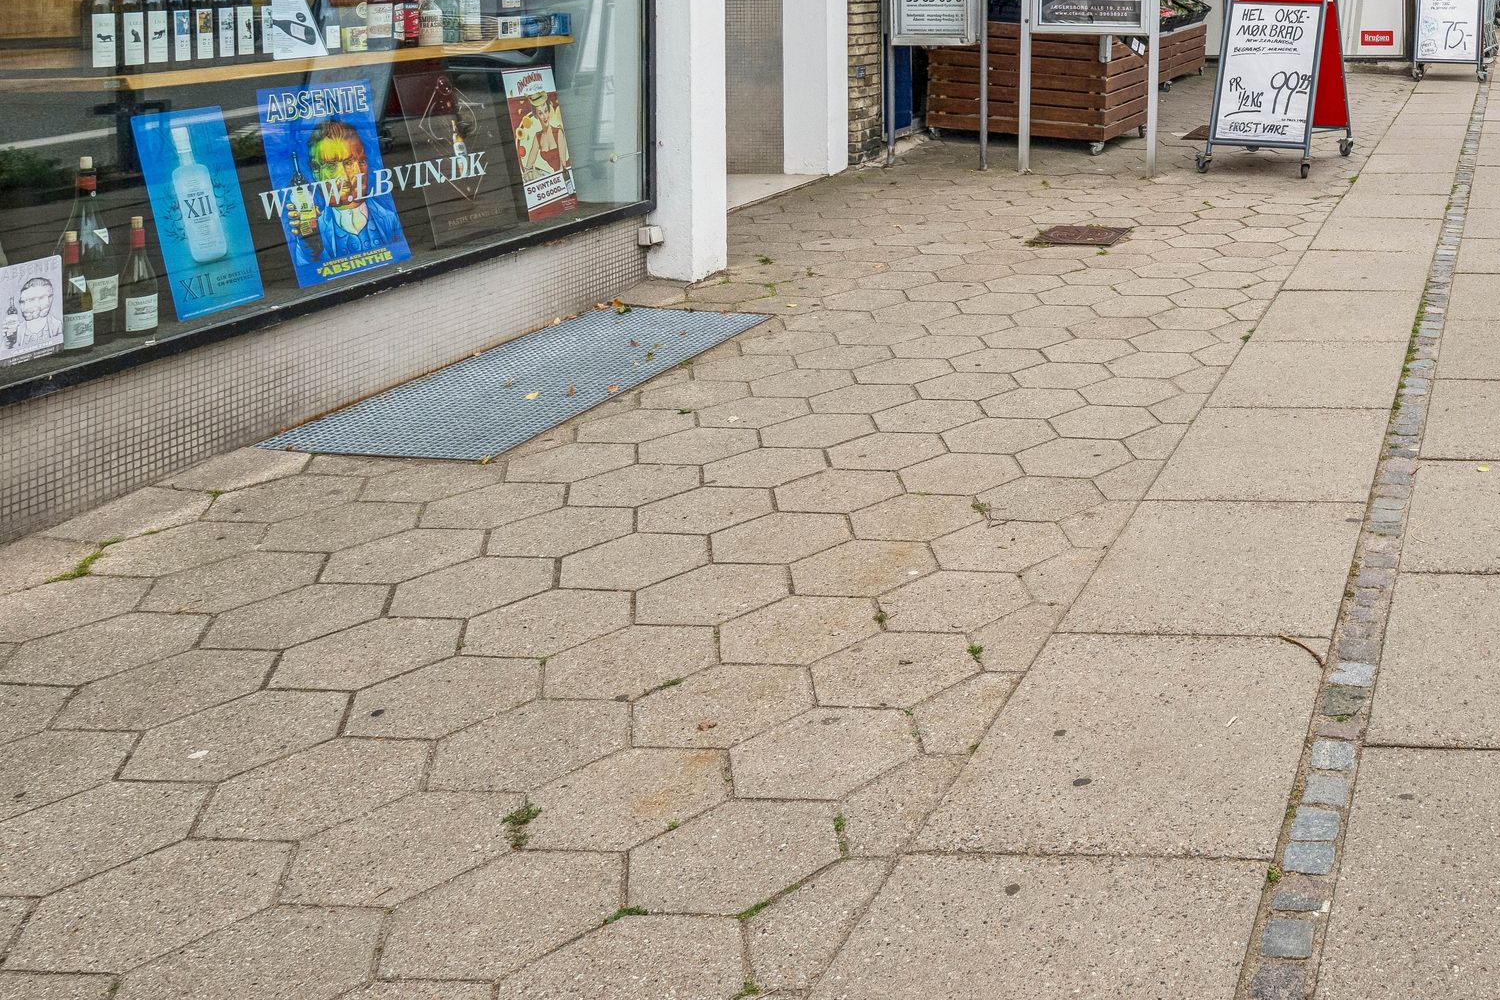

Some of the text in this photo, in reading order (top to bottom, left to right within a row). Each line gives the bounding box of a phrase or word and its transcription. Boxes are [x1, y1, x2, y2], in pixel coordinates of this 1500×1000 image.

[1241, 8, 1265, 21] HEL
[1364, 33, 1390, 42] Brugsen
[1229, 76, 1246, 92] PR.
[266, 85, 370, 123] ABSENTE
[258, 151, 487, 220] WWW.LBVIN.DK
[536, 176, 562, 191] VINTAGE
[183, 195, 213, 219] XII
[179, 273, 215, 303] XII
